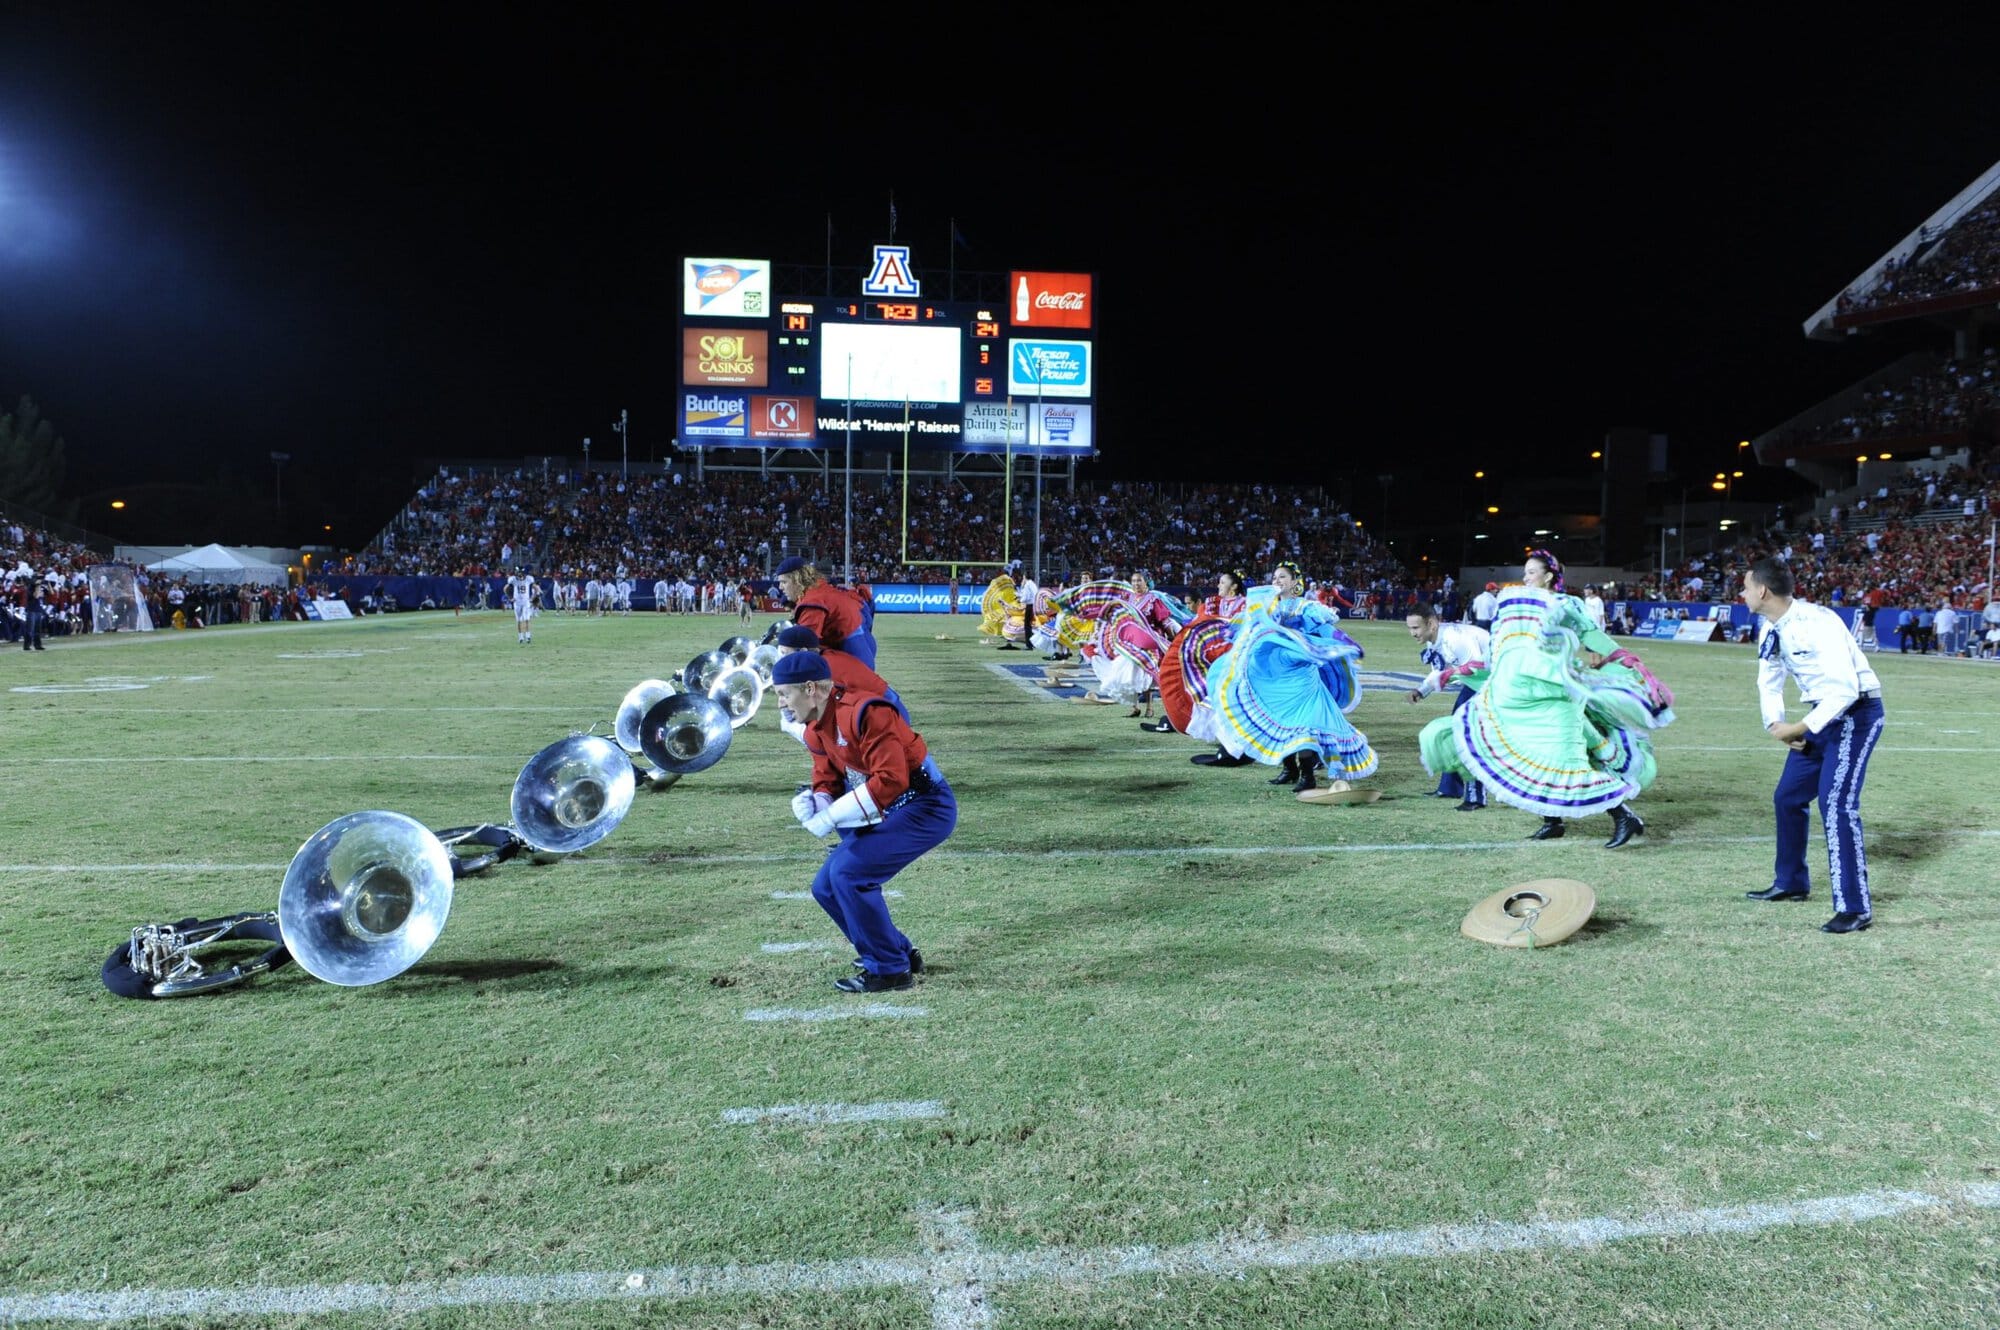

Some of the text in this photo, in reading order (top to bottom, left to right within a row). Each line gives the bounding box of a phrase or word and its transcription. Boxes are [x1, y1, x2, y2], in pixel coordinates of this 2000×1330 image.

[862, 245, 919, 297] A
[877, 304, 917, 319] 7:23
[977, 323, 998, 336] 24
[699, 336, 754, 361] SOL
[1032, 347, 1070, 359] Tucson
[699, 361, 754, 374] CASINOS
[1035, 359, 1080, 370] Electric
[1041, 369, 1080, 380] Power
[976, 380, 992, 392] 25
[686, 395, 744, 416] Budget
[817, 418, 861, 431] Wildcat
[917, 421, 961, 433] Raisers
[965, 417, 997, 432] Daily
